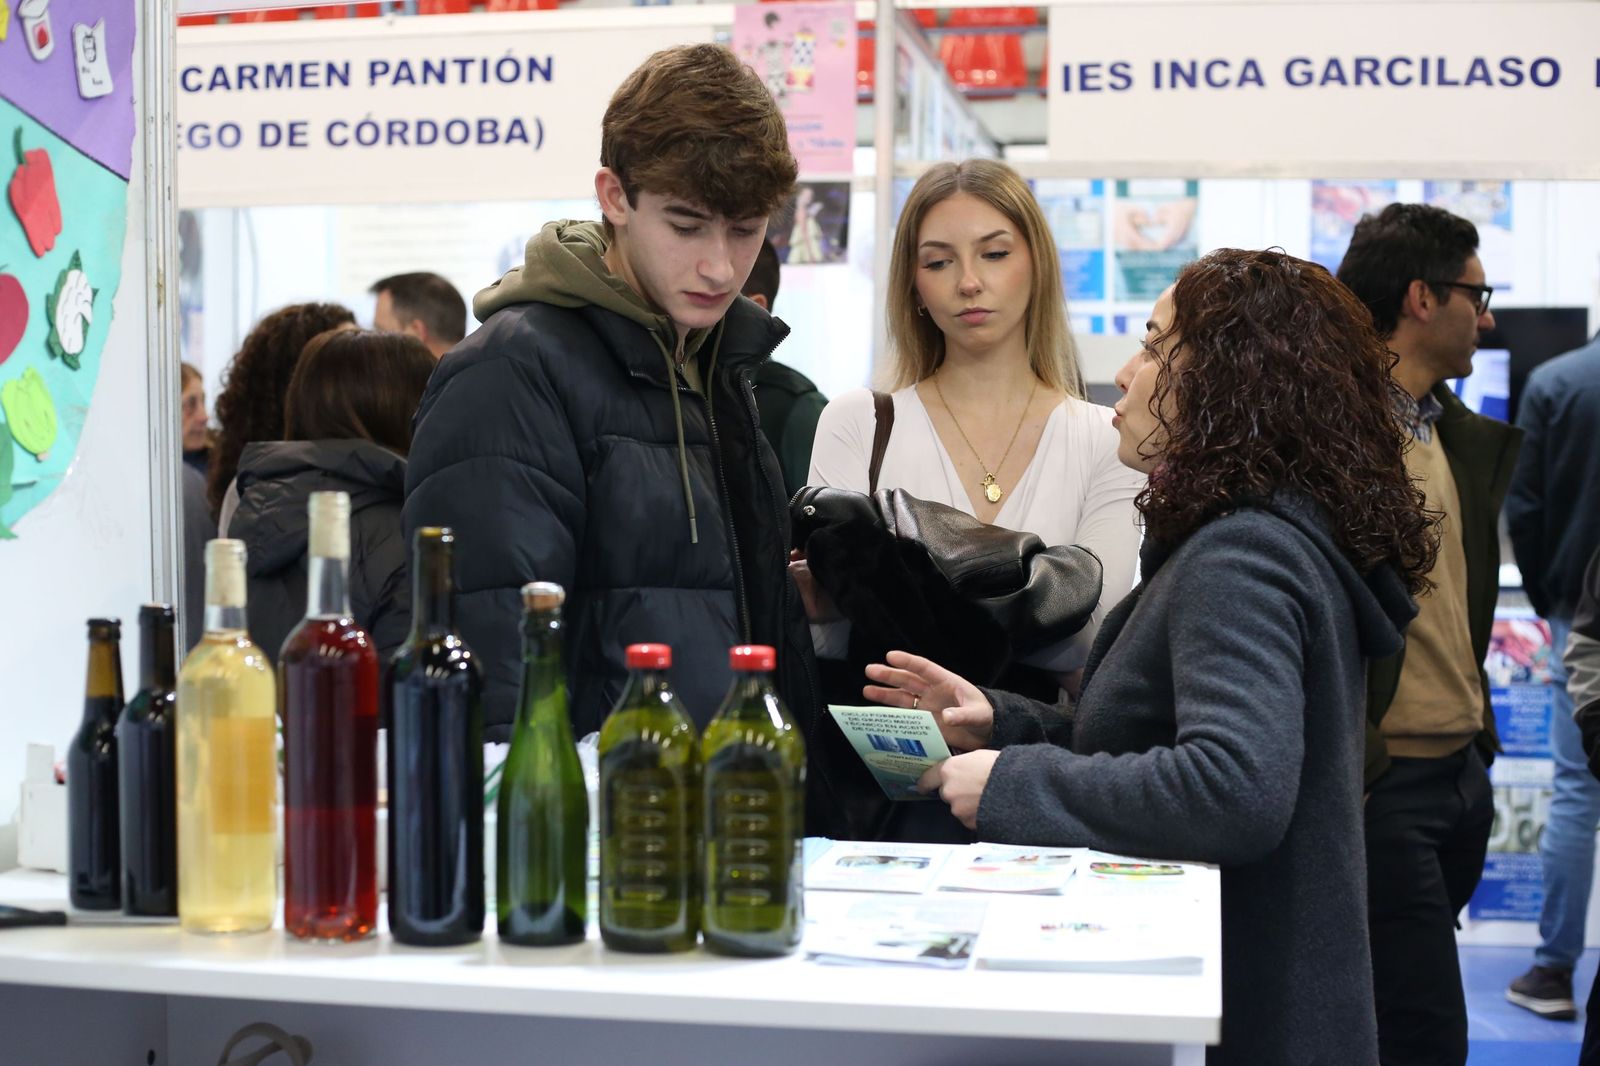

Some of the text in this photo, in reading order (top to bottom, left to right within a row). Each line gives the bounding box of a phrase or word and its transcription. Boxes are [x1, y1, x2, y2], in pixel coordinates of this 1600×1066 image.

[180, 49, 554, 93] CARMEN PANTIÓN
[1063, 61, 1133, 92] IES
[1153, 60, 1266, 90] INCA
[1284, 56, 1561, 88] GARCILASO
[259, 121, 308, 148] DE
[326, 112, 545, 150] CÓRDOBA)
